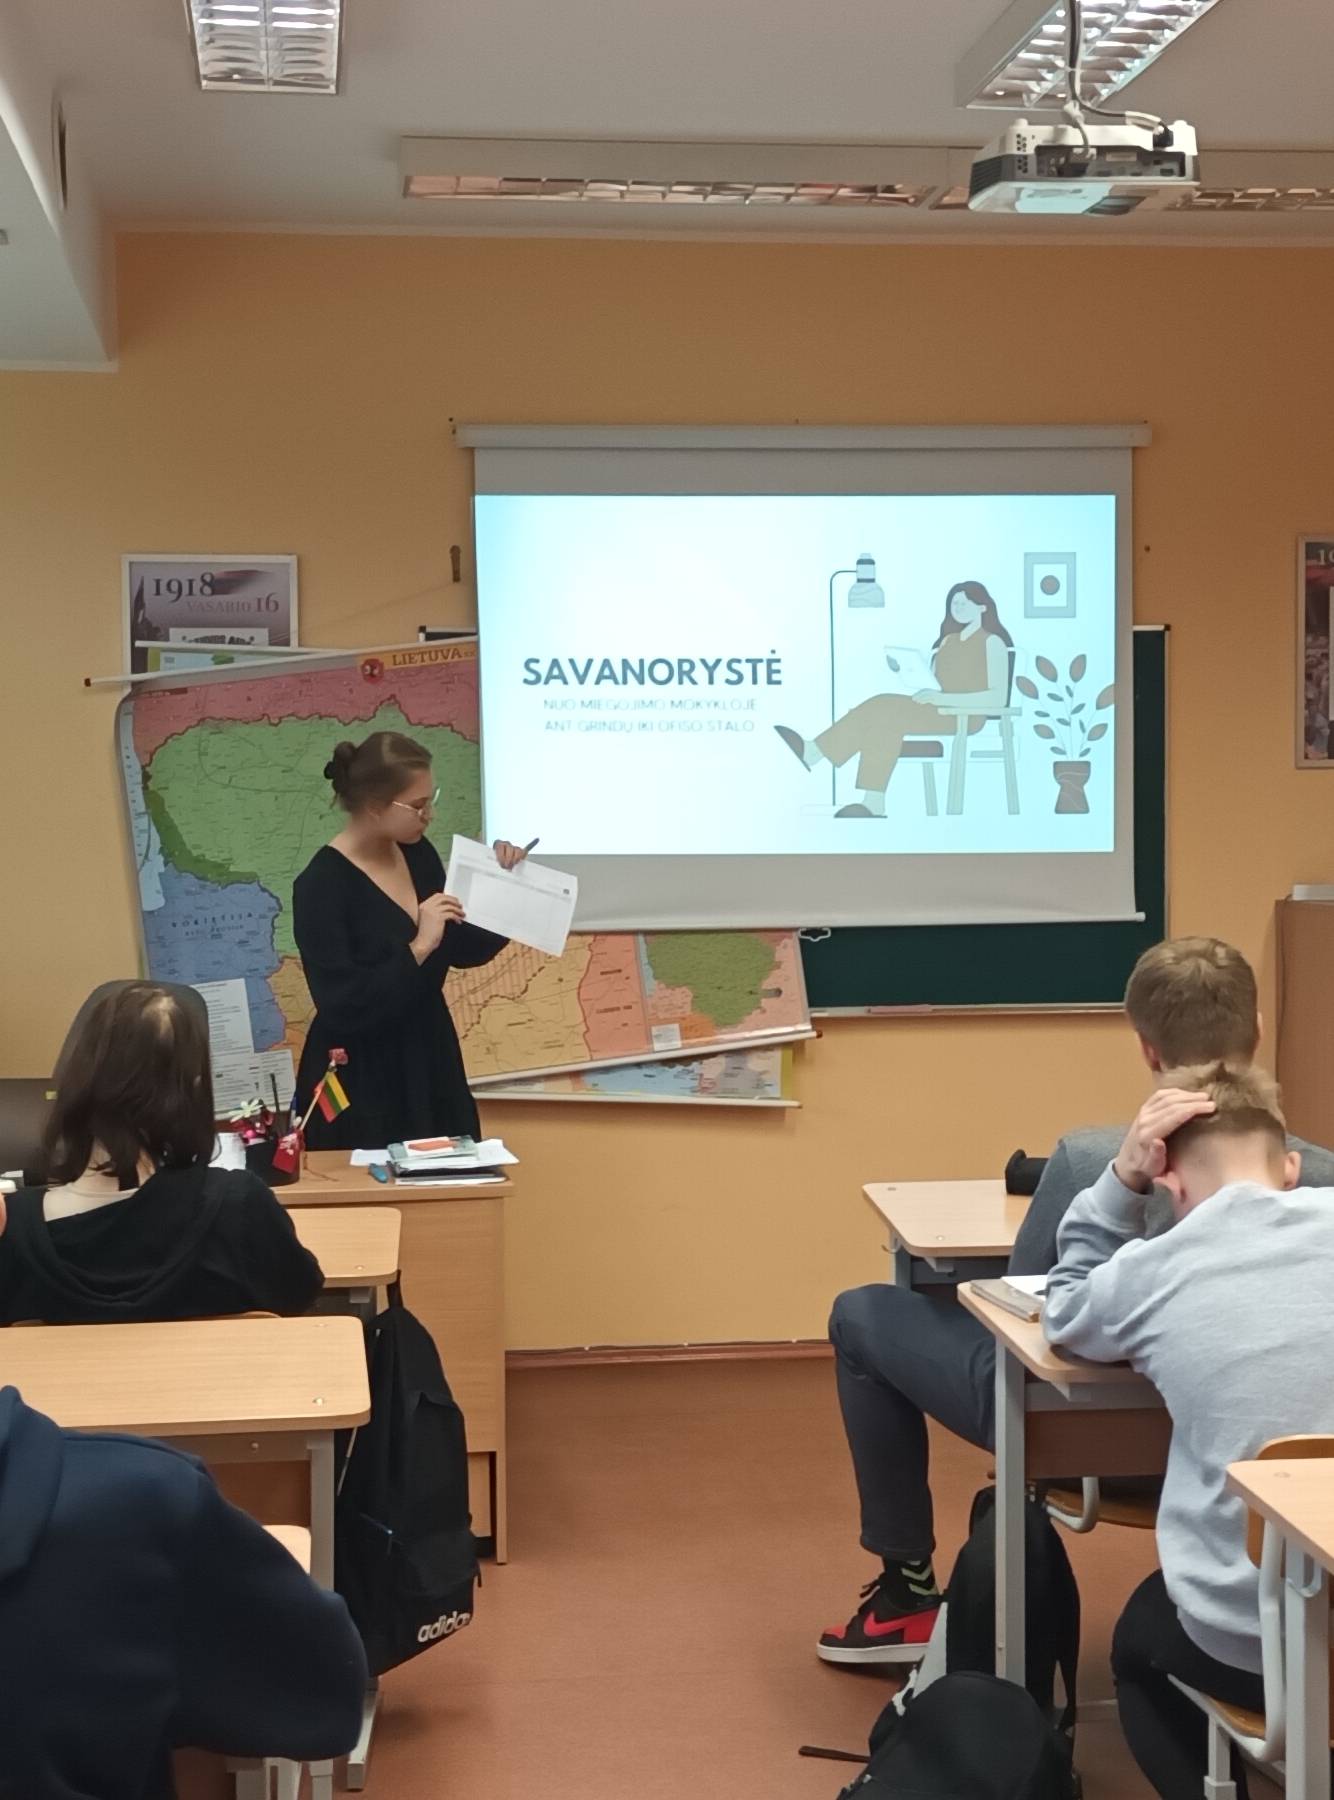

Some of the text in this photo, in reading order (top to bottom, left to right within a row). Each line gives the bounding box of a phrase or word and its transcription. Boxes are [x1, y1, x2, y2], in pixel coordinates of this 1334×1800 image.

[153, 572, 215, 603] 1918
[185, 592, 279, 612] VASARIO 16
[392, 648, 462, 666] LIETUVA
[523, 649, 782, 686] SAVANORYSTĖ
[544, 699, 757, 711] NUO MIEGOJIMO MOKYKLOJE
[545, 720, 755, 734] ANT GRINDŲ IKI OFISO STALO
